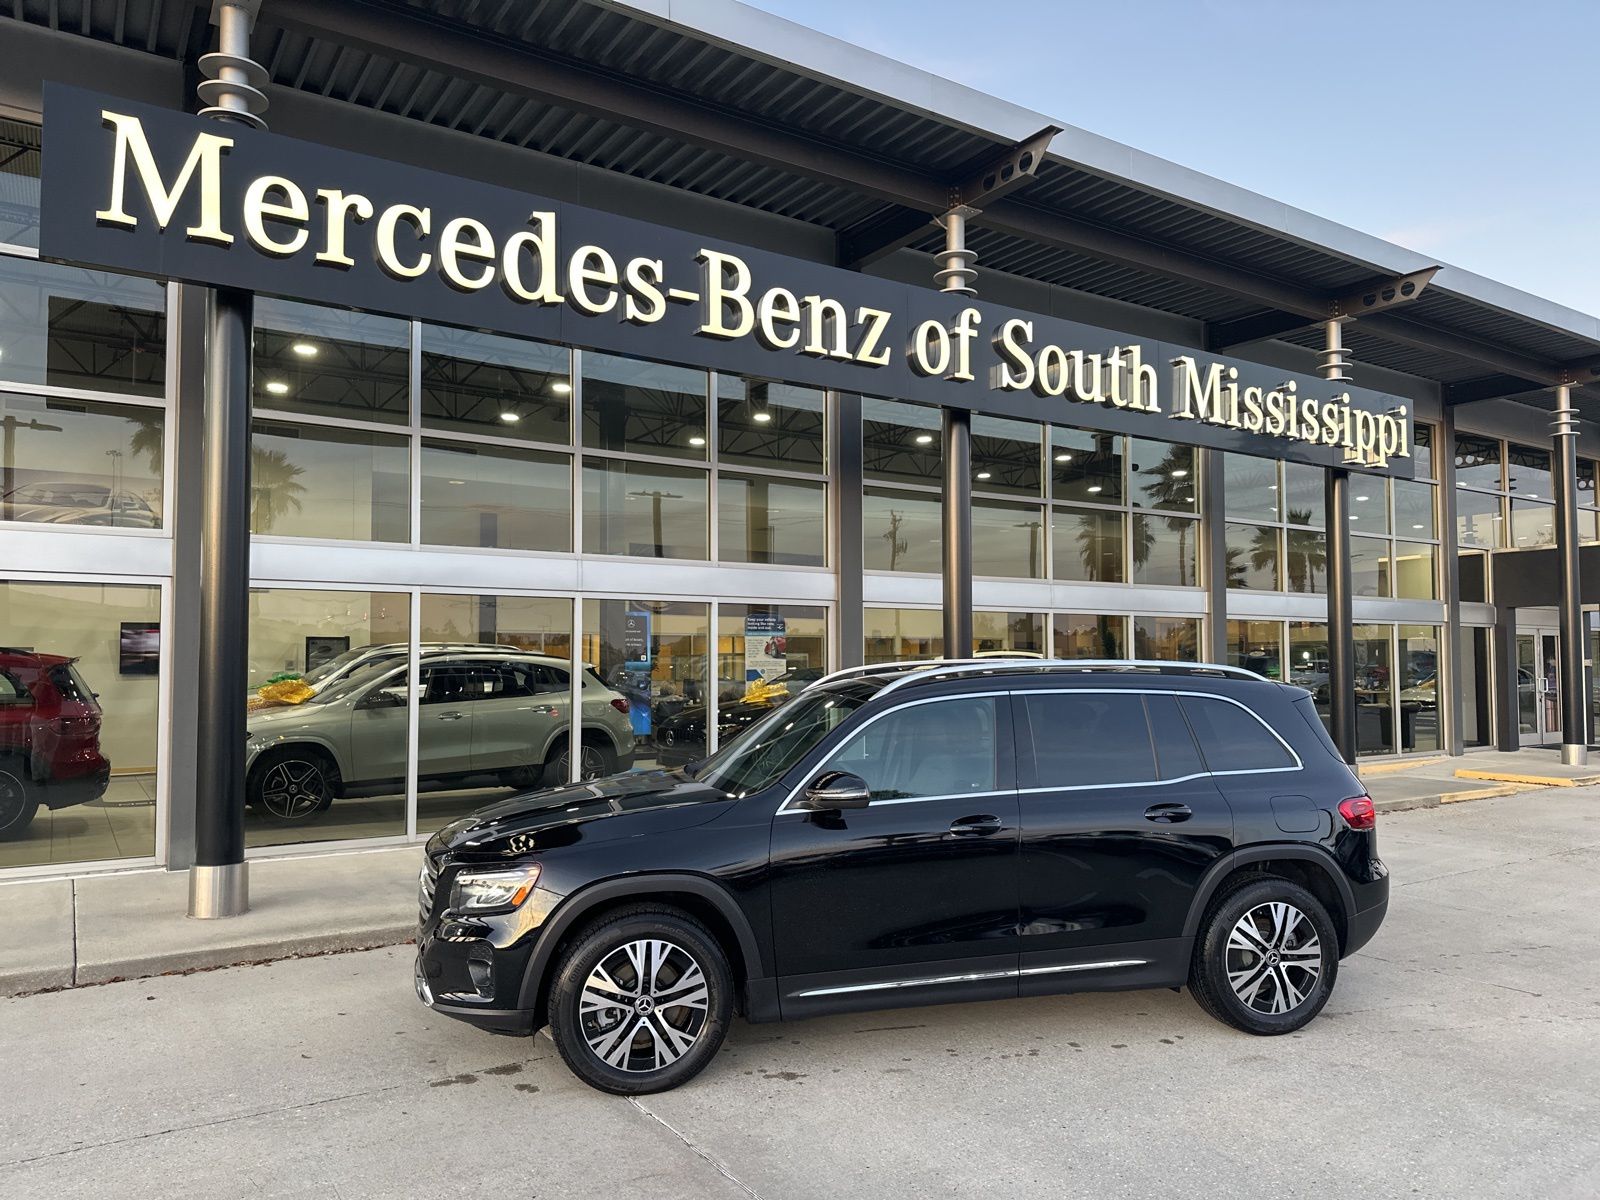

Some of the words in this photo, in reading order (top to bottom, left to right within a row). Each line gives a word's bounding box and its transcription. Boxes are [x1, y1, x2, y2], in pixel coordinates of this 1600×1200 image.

[96, 110, 892, 367] Mercedes-Benz
[910, 307, 982, 382] of
[993, 318, 1162, 414] South
[1170, 355, 1411, 468] Mississippi
